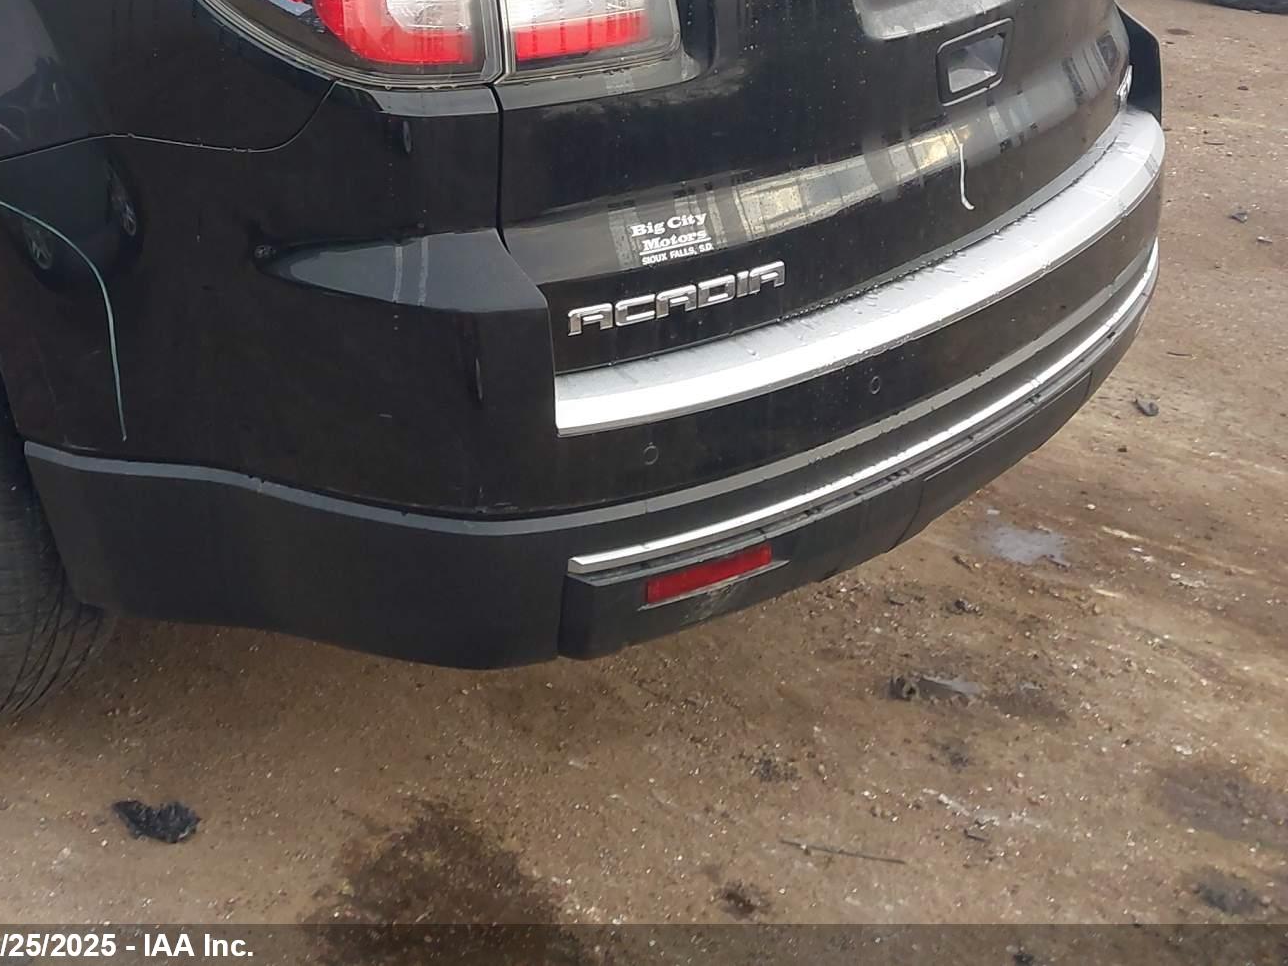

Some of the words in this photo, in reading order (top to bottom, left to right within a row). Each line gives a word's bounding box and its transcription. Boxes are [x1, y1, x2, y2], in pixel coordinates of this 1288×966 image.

[630, 221, 666, 238] Big
[666, 212, 707, 229] City
[641, 229, 708, 251] Motors
[641, 252, 668, 266] SIOUX
[669, 246, 698, 259] FALLS,
[567, 260, 786, 337] ACADIA
